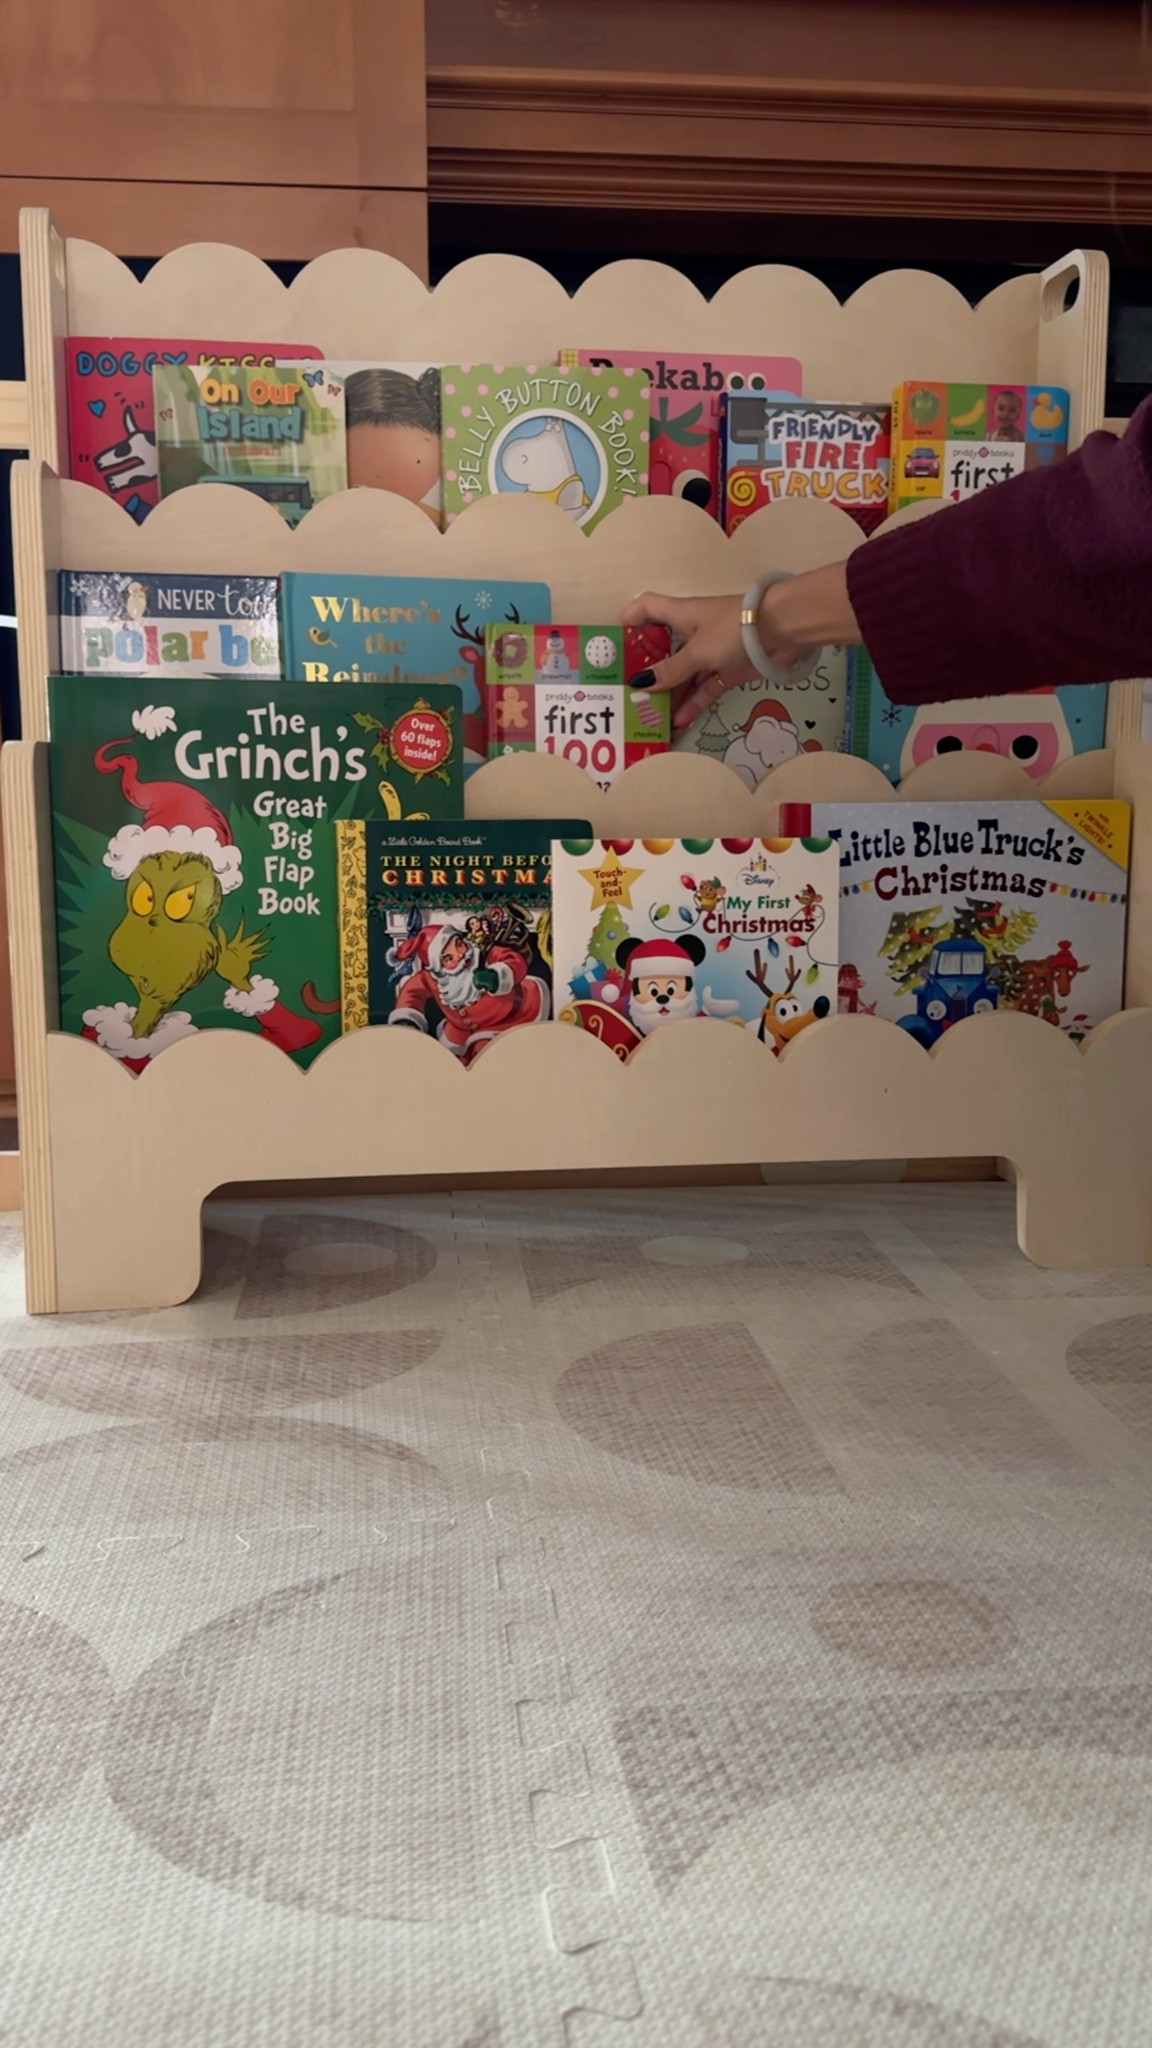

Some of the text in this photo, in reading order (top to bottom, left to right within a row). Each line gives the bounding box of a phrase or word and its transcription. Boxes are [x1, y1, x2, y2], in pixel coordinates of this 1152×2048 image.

[76, 351, 188, 376] DOGGY
[200, 378, 300, 406] On Our
[197, 407, 303, 441] Island
[458, 405, 497, 494] BELLY
[495, 377, 602, 416] BUTTON
[599, 411, 637, 497] BOOK!
[772, 420, 876, 441] FRIENDLY
[785, 441, 861, 469] FIRE
[952, 448, 1015, 459] priddy books
[765, 470, 888, 499] TRUCK
[950, 460, 1014, 489] first
[157, 584, 275, 616] NEVER tou
[310, 596, 442, 624] Where's
[84, 624, 277, 667] polar be
[364, 632, 406, 655] the
[545, 691, 615, 703] priddy books
[246, 702, 305, 737] The
[411, 717, 436, 732] Over
[544, 704, 615, 735] first
[401, 731, 442, 748] 60 flaps
[174, 725, 368, 782] Grinch's
[404, 746, 438, 762] inside!
[544, 736, 616, 773] 100
[253, 791, 327, 819] Great
[269, 822, 313, 860] Big
[388, 836, 408, 846] Little
[409, 836, 436, 846] Golden
[438, 836, 462, 846] Board
[828, 819, 1085, 867] Little Blue Truck's
[264, 856, 315, 890] Flap
[380, 855, 553, 867] THE NIGHT BEFO
[593, 867, 627, 880] Touch-
[381, 868, 553, 886] CHRISTMA
[600, 880, 622, 889] and-
[743, 873, 775, 888] Disney
[874, 864, 1047, 900] Christmas
[258, 888, 321, 915] Book
[602, 887, 623, 898] Feel
[727, 896, 791, 913] My First
[703, 914, 815, 933] Christmas
